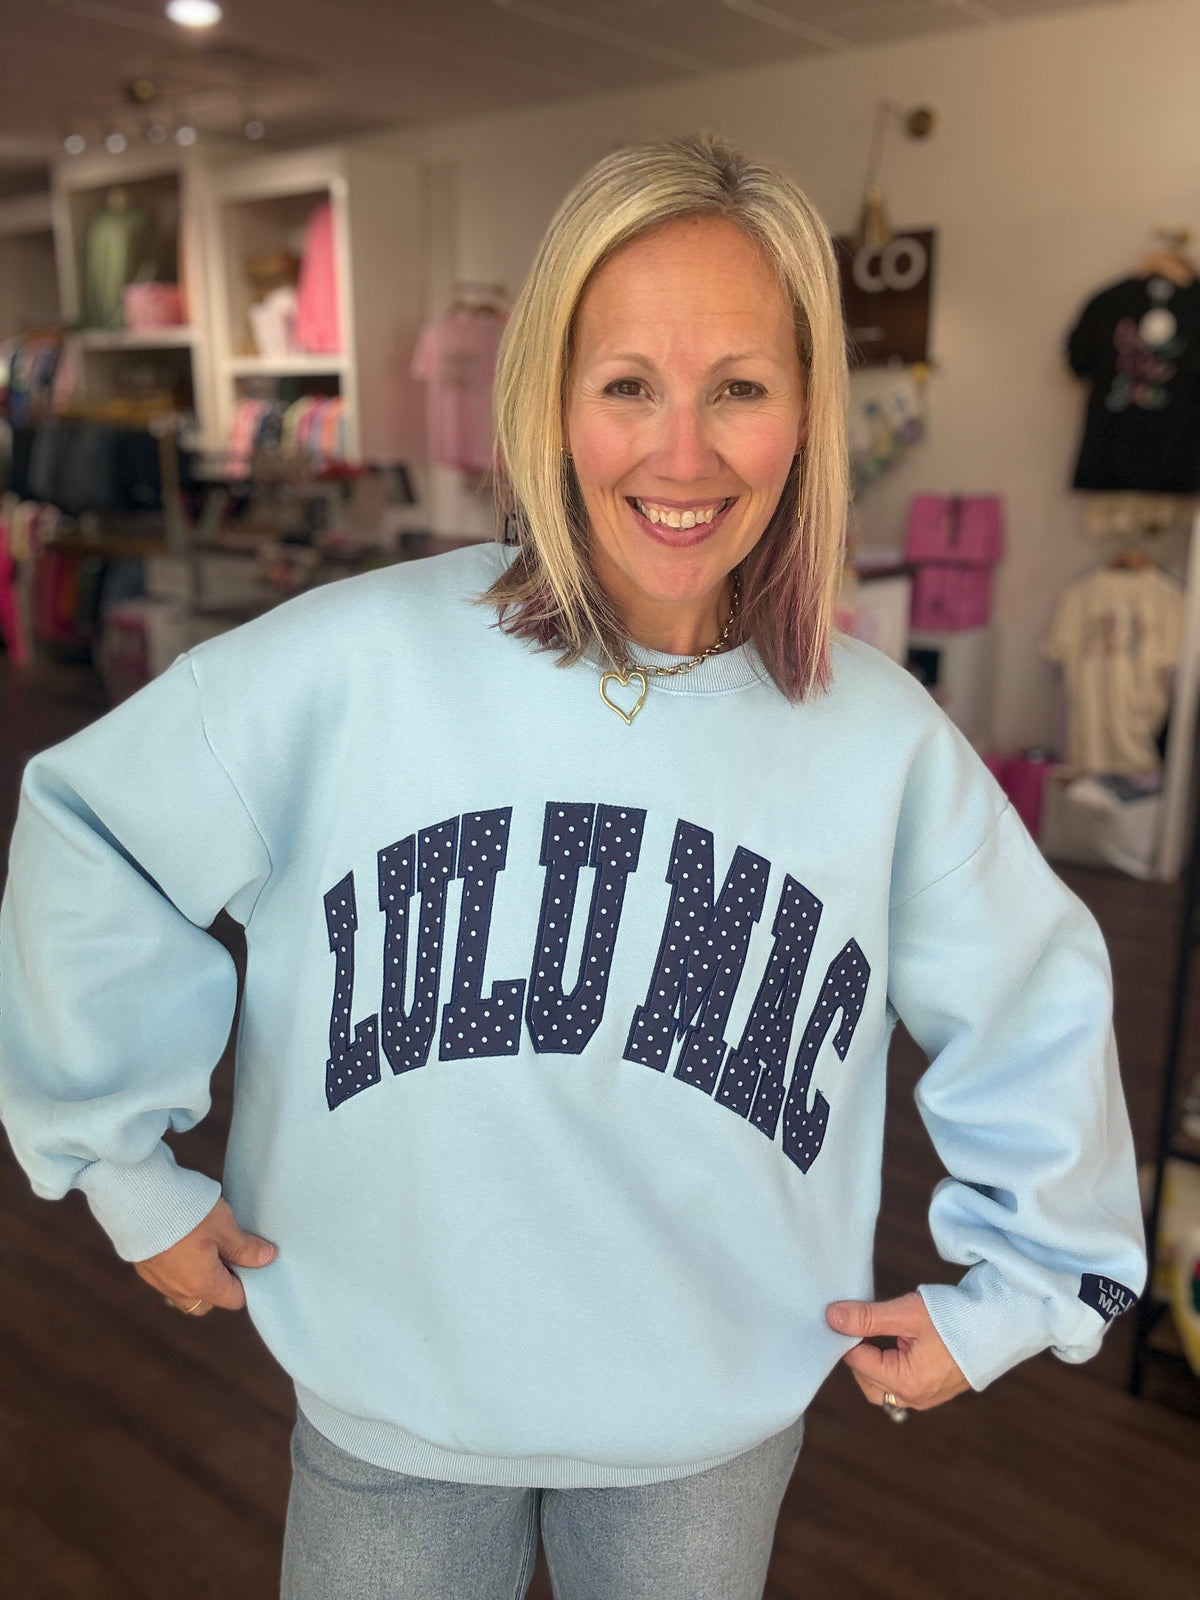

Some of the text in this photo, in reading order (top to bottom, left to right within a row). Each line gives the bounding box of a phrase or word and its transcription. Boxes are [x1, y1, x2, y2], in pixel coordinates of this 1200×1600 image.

[323, 801, 871, 1175] LULU MAC
[1098, 1293, 1122, 1316] MA
